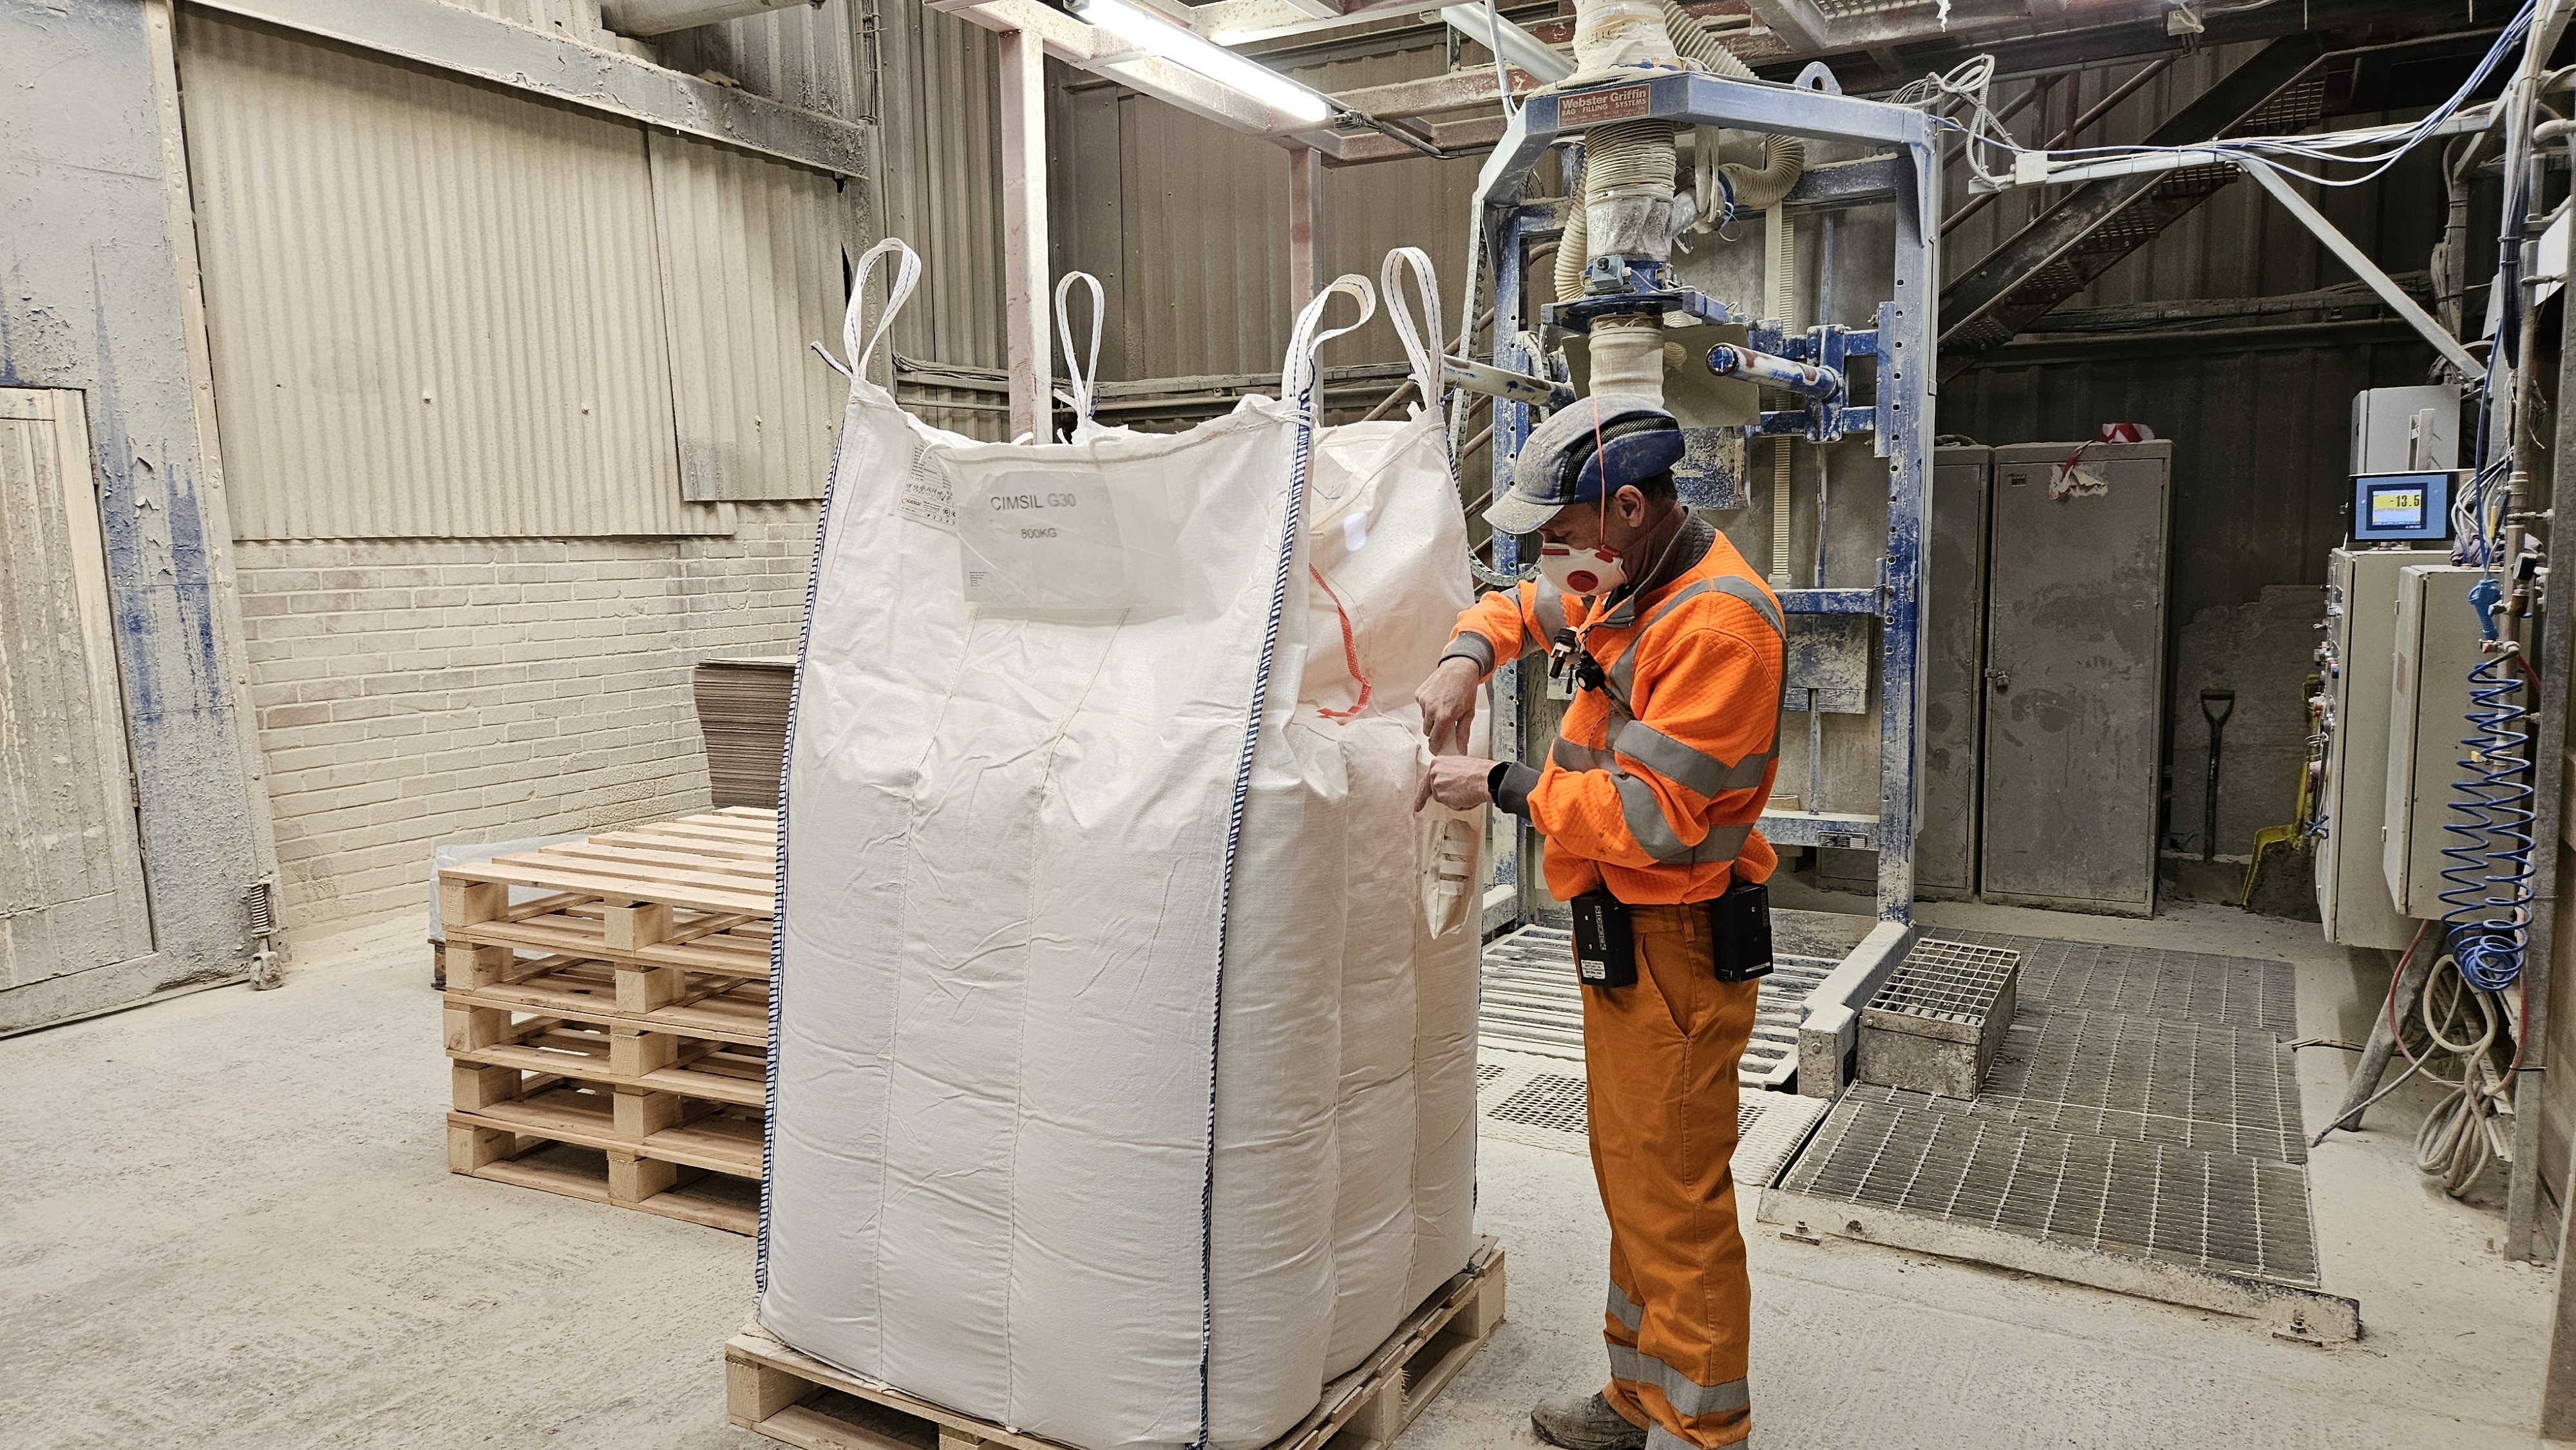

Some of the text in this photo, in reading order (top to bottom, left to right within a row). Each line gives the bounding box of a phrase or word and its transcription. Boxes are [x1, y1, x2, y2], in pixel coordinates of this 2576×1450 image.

[1562, 88, 1646, 109] Webster Griffin
[1562, 98, 1647, 117] BAG FILLING SYSTEMS
[990, 493, 1076, 511] CIMSIL G30
[2390, 494, 2420, 507] -13.5
[1021, 527, 1057, 539] 800KG
